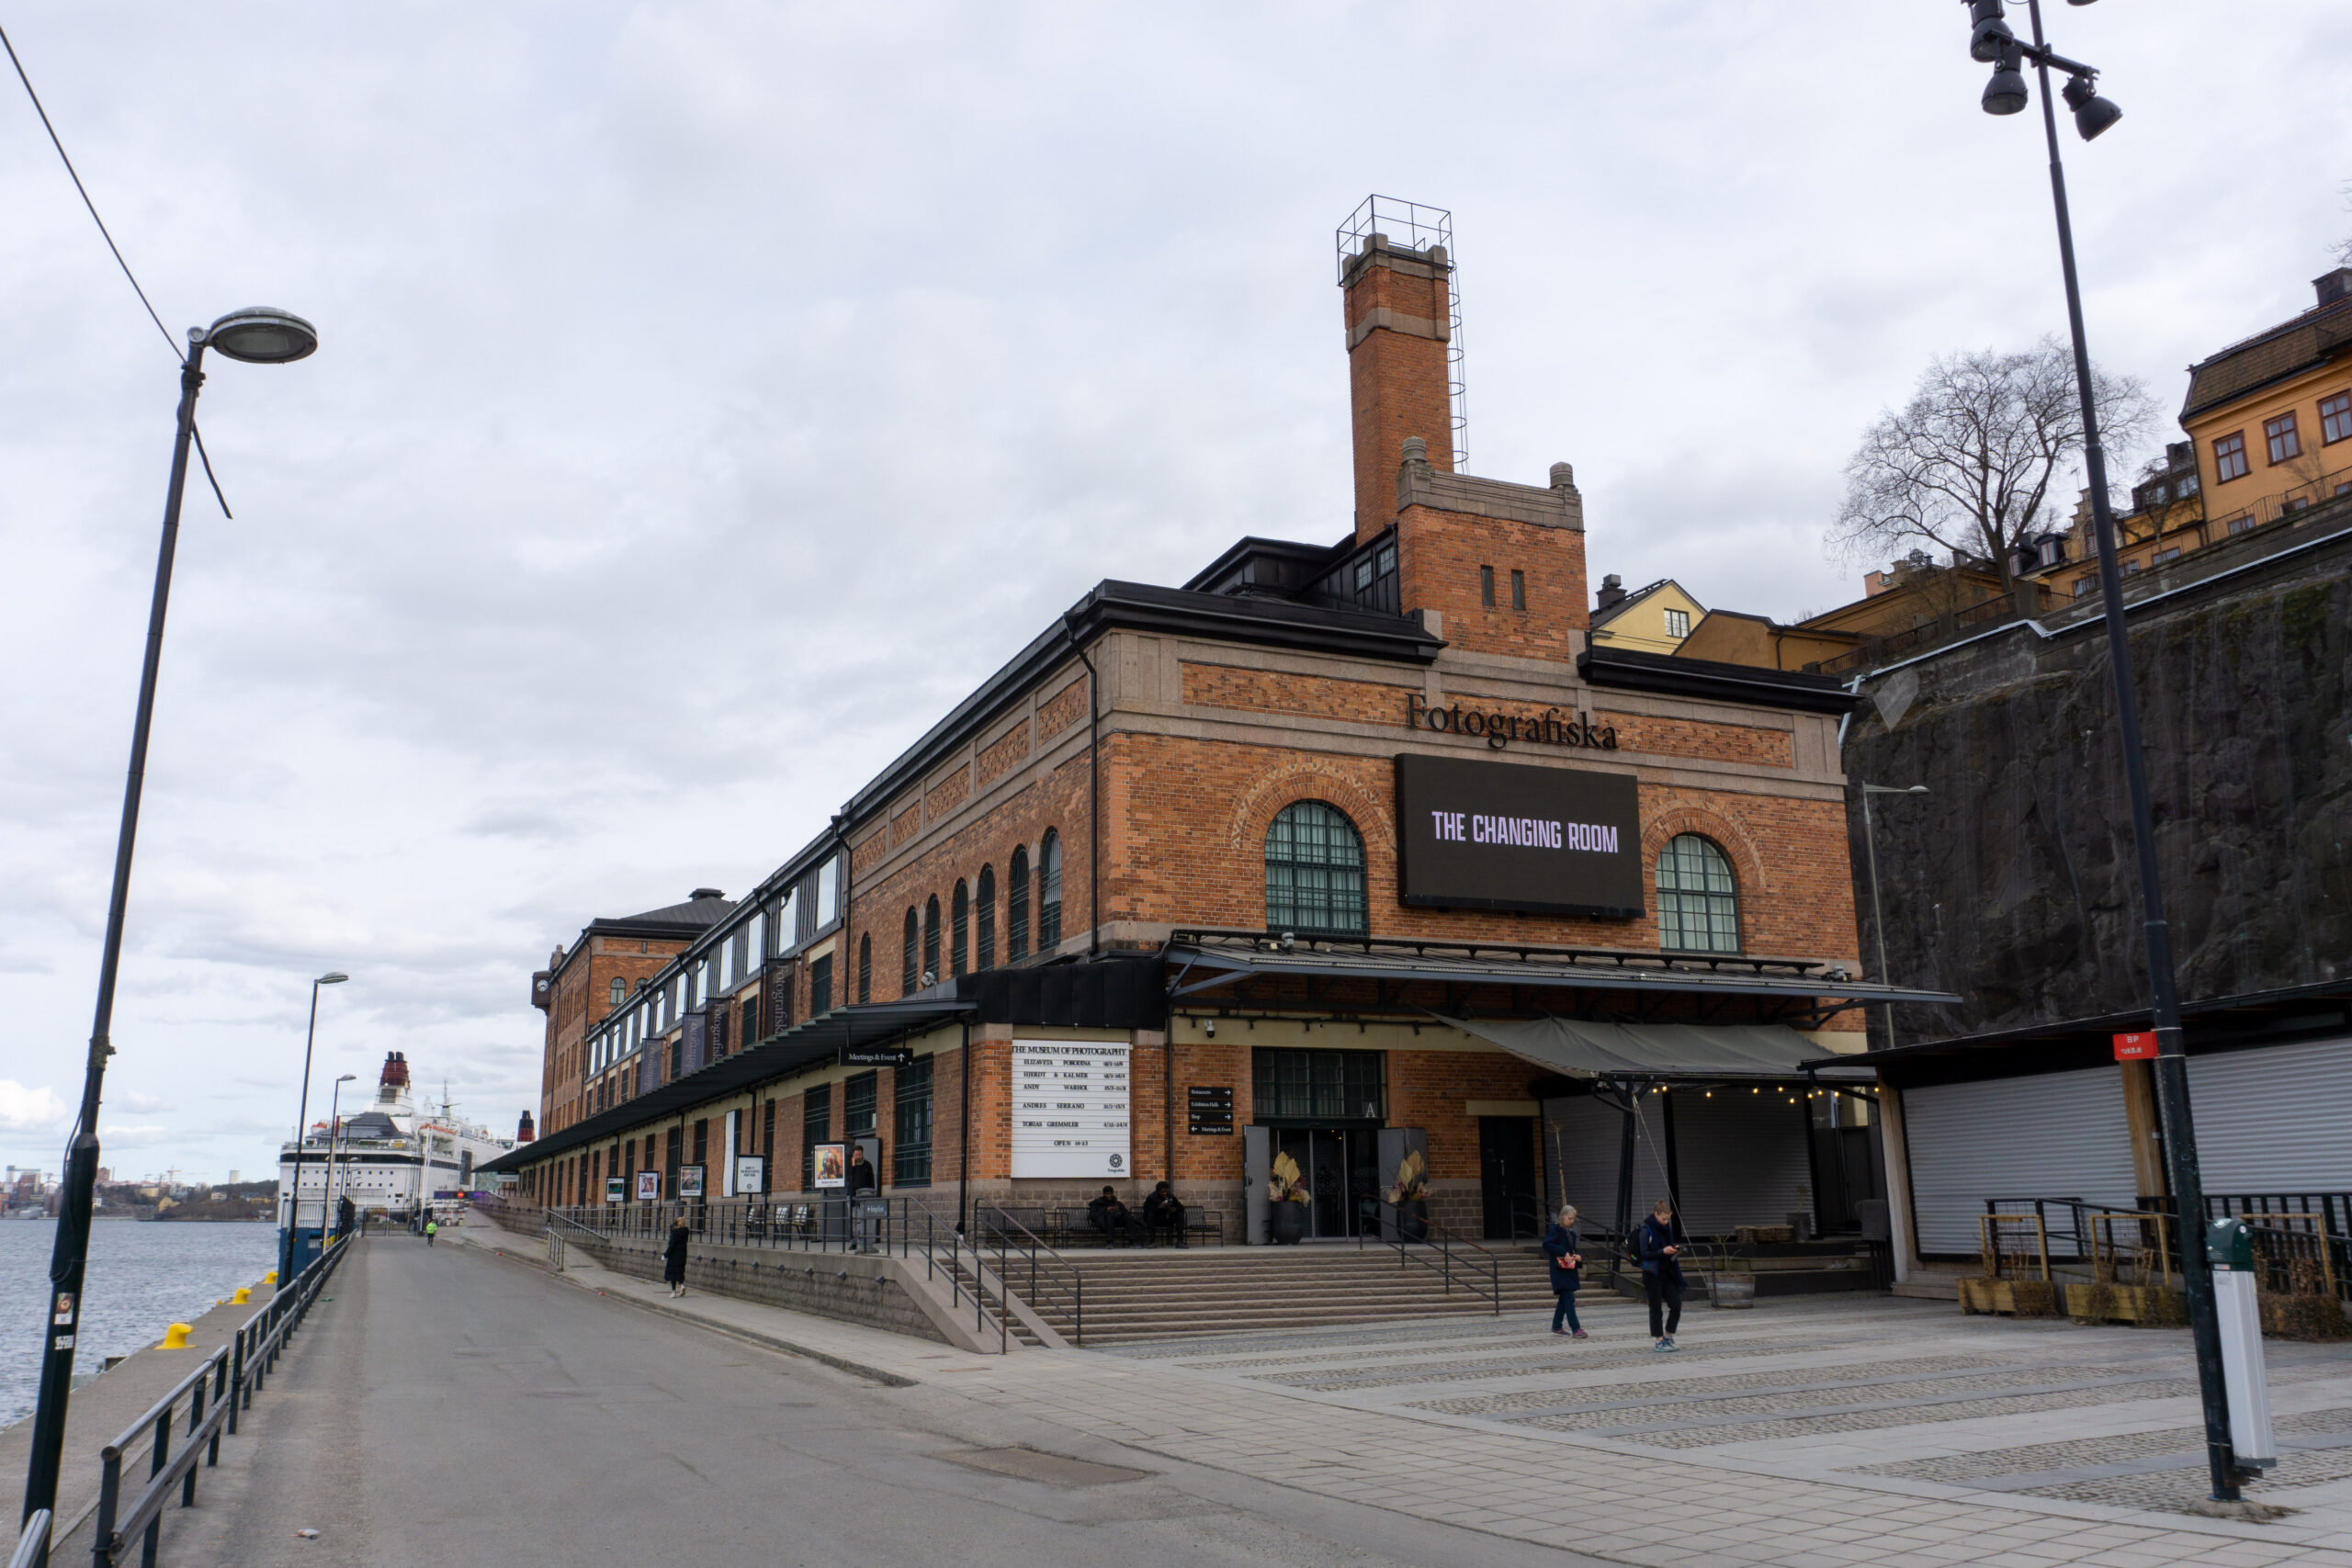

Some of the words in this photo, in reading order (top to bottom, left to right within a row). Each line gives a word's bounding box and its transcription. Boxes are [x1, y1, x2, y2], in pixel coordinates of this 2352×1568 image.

[1405, 693, 1619, 750] Fotografiska
[1431, 810, 1466, 841] THE
[1473, 814, 1562, 849] CHANGING
[1567, 822, 1619, 853] ROOM
[2127, 1035, 2139, 1043] BP
[1028, 1046, 1059, 1055] MUSEUM
[1072, 1047, 1127, 1056] PHOTOGRAPHY
[848, 1053, 874, 1062] Meetings
[1365, 1102, 1376, 1117] A
